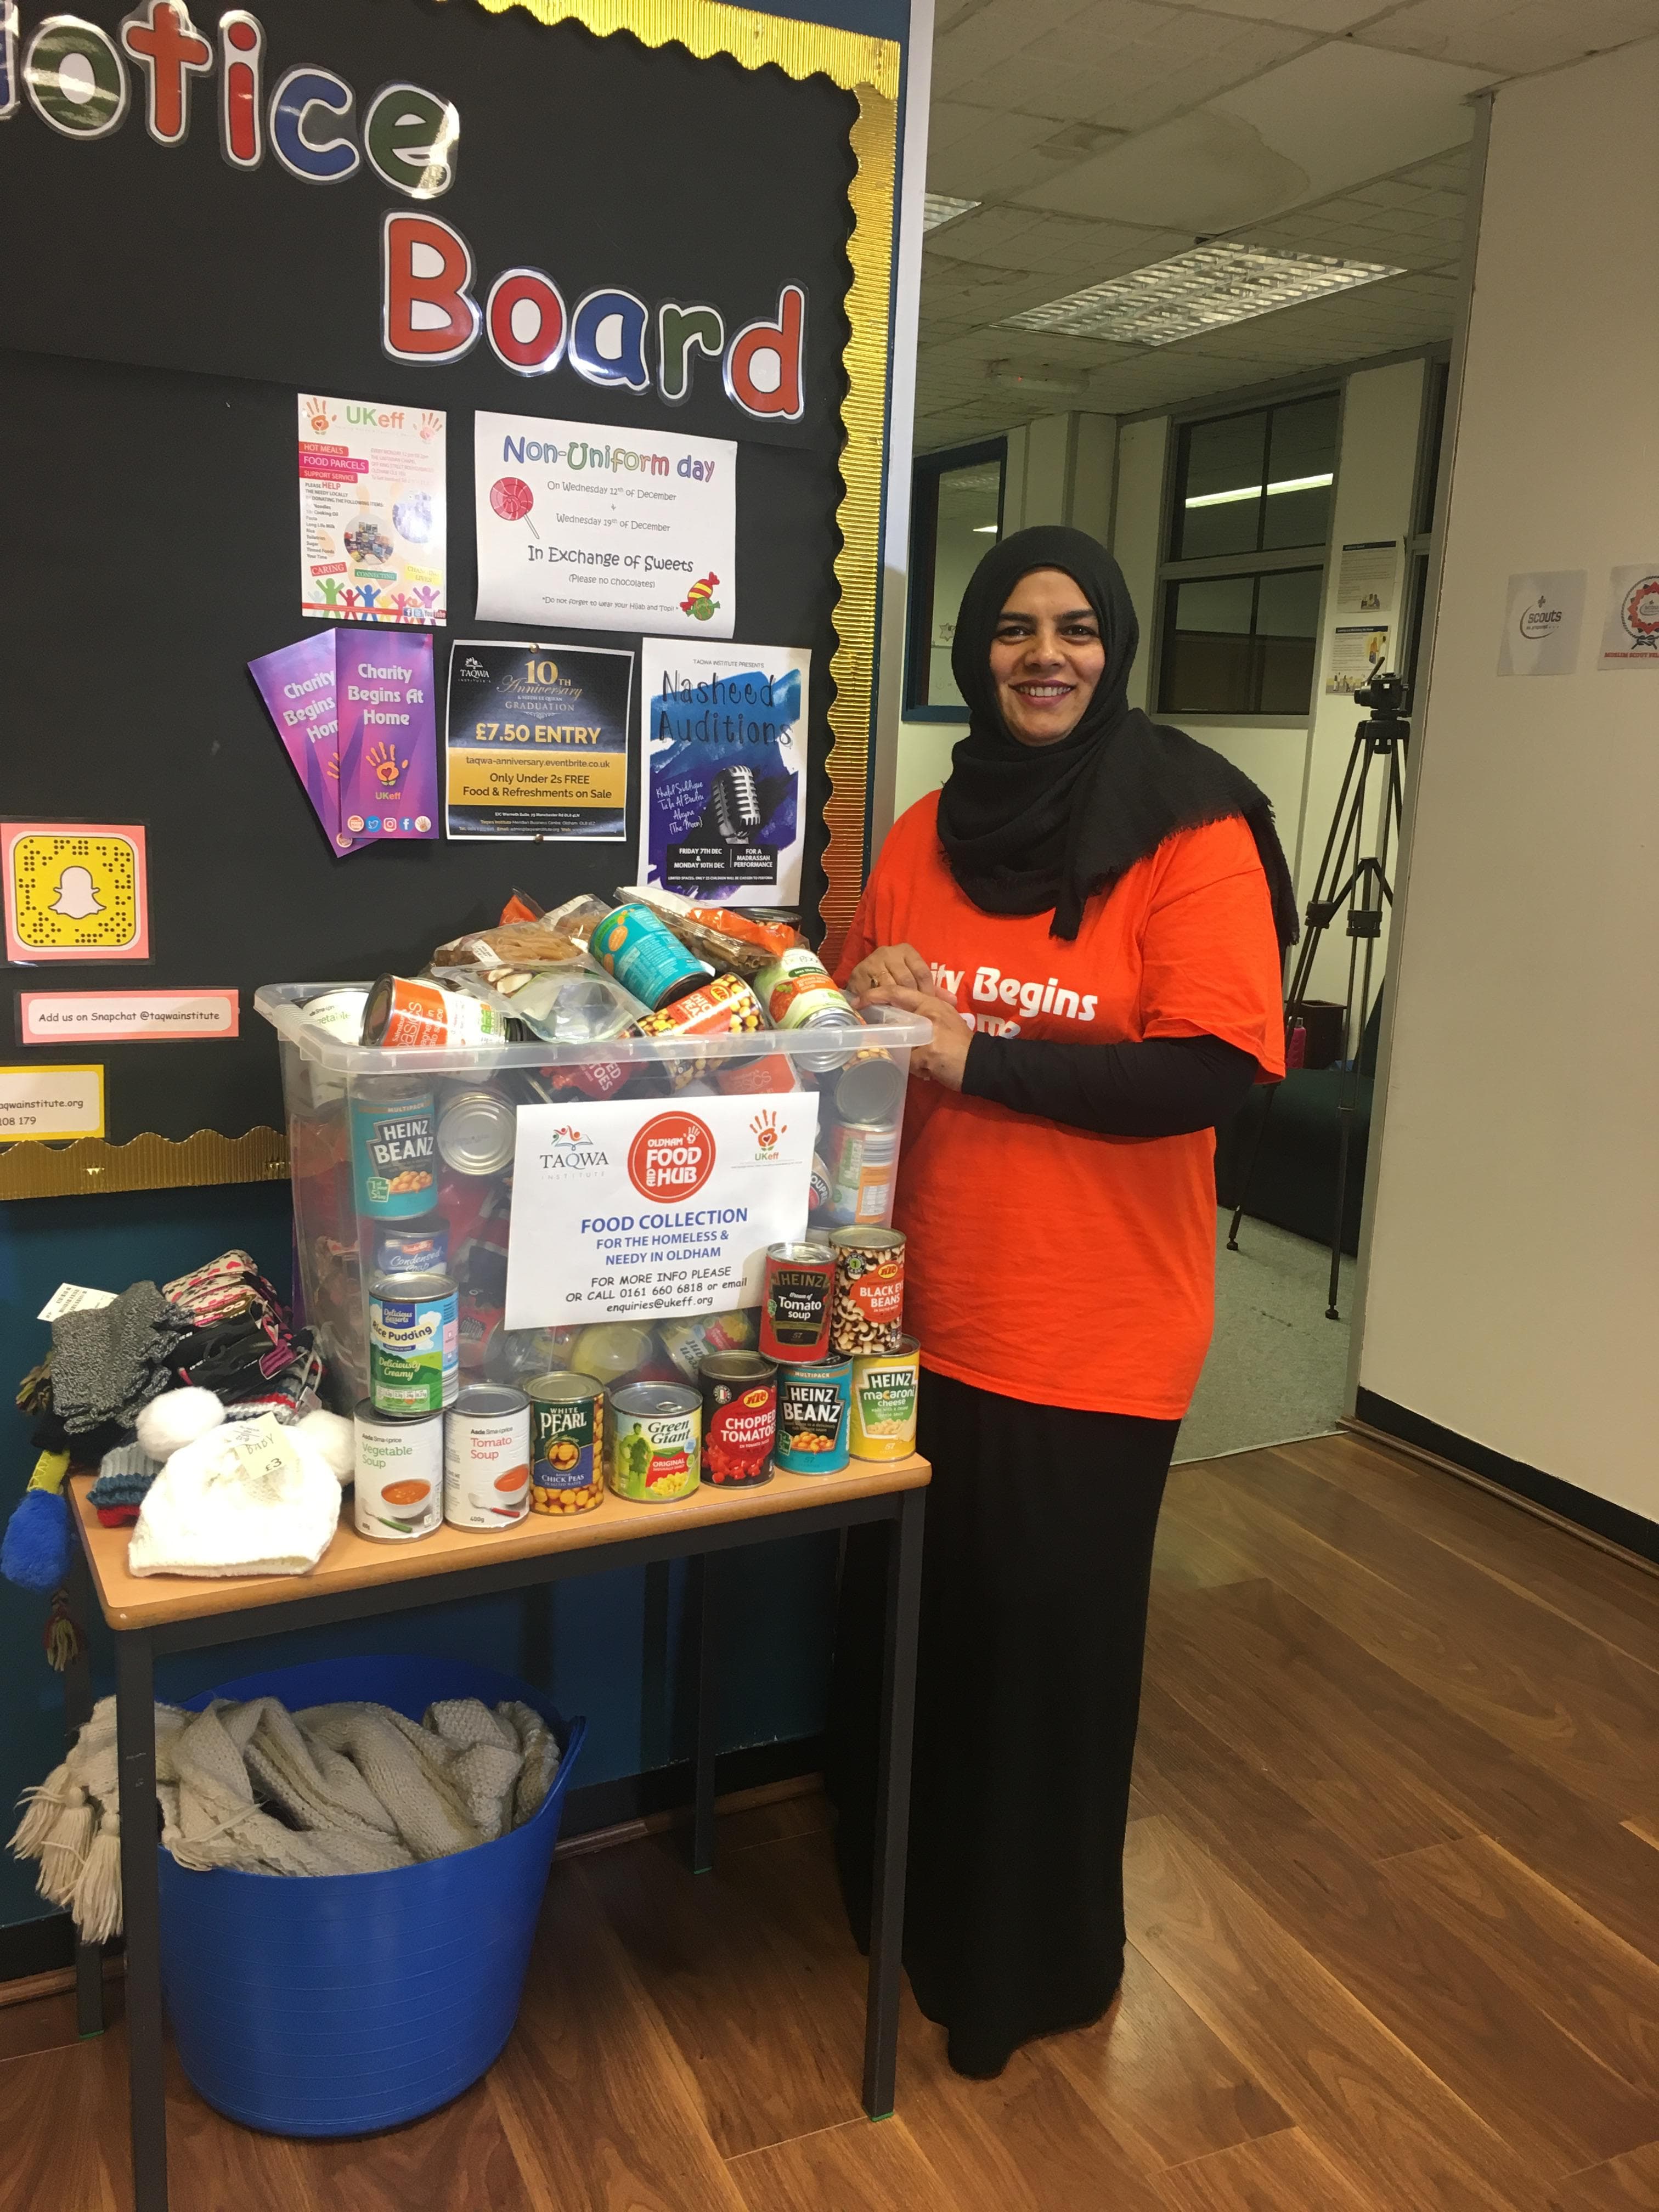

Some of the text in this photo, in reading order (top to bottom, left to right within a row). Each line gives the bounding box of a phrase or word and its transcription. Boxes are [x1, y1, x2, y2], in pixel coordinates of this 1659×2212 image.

[382, 211, 805, 420] Board
[346, 405, 404, 429] UKeff
[304, 443, 343, 455] HOT MEALS
[304, 456, 365, 470] FOOD PARCELS
[503, 435, 715, 483] Non-Uniform day
[304, 470, 355, 482] SUPPORT SERVICE
[322, 482, 341, 490] HELP
[548, 481, 676, 501] On Wednesday 12th of December
[556, 513, 670, 532] Wednesday 19th of December
[528, 545, 694, 572] In Exchange of Sweets
[312, 564, 345, 575] CARING
[357, 571, 395, 579] CONNECTING
[568, 574, 597, 584] (Please
[1528, 610, 1562, 623] scouts
[358, 663, 412, 684] Charity
[460, 669, 490, 678] TAQWA
[284, 670, 336, 699] Charity
[496, 675, 583, 701] Anniversary
[663, 670, 775, 707] Nasheed
[348, 686, 424, 704] Begins At
[283, 697, 336, 726] Begins
[505, 701, 574, 712] GRADUATION
[364, 709, 410, 726] Home
[476, 723, 602, 744] £7.50 ENTRY
[659, 710, 793, 745] Auditions
[466, 756, 610, 768] taqwa-anniversary.eventbrite.co.uk
[490, 773, 590, 785] Only Under 2s FREE
[375, 792, 401, 800] UKeff
[463, 786, 612, 799] Food & Refreshments on Sale
[973, 966, 1098, 1022] Begins
[39, 1013, 59, 1023] Add
[91, 1012, 137, 1023] Snapchat
[140, 1012, 220, 1022] @taqwainstitute
[388, 1104, 425, 1113] MULTIPACK
[19, 1117, 36, 1125] 179
[383, 1120, 428, 1141] HEINZ
[374, 1136, 434, 1164] BEANZ
[647, 1137, 683, 1148] OLDHAM
[540, 1152, 609, 1170] TAQWA
[646, 1147, 702, 1169] FOOD
[755, 1152, 779, 1161] UKeff
[646, 1169, 656, 1187] AID
[657, 1166, 697, 1187] HUB
[581, 1207, 748, 1234] FOOD COLLECTION
[596, 1230, 730, 1249] FOR THE HOMELESS &
[391, 1246, 442, 1266] Condensed
[606, 1247, 721, 1265] NEEDY IN OLDHAM
[591, 1266, 731, 1287] FOR MORE INFO PLEASE
[781, 1273, 823, 1288] HEINZ
[566, 1293, 582, 1302] OR
[587, 1291, 615, 1301] CALL
[620, 1288, 646, 1298] 0161
[652, 1285, 673, 1295] 660
[677, 1283, 703, 1294] 6818
[722, 1277, 747, 1289] email
[860, 1285, 893, 1297] BLACK
[607, 1295, 713, 1313] enquiries@ukeff.org
[778, 1296, 822, 1311] Tomato
[871, 1293, 900, 1308] BEANS
[384, 1308, 413, 1318] Delicious
[788, 1311, 811, 1321] soup
[373, 1321, 432, 1341] Rice Pudding
[379, 1357, 421, 1372] Deliciously
[384, 1368, 414, 1381] Creamy
[871, 1373, 911, 1389] HEINZ
[791, 1387, 833, 1402] HEINZ
[864, 1386, 915, 1401] macaroni
[725, 1409, 776, 1430] CHOPPED
[783, 1402, 840, 1423] BEANZ
[540, 1412, 587, 1439] PEARL
[648, 1420, 689, 1433] Green
[245, 1433, 274, 1455] BABY
[471, 1437, 512, 1448] Tomato
[651, 1429, 691, 1444] Giant
[362, 1442, 413, 1457] Vegetable
[471, 1449, 499, 1460] Soup
[265, 1458, 282, 1471] £3
[362, 1455, 386, 1469] Soup
[653, 1458, 685, 1468] ORIGINAL
[541, 1474, 566, 1482] CHICK
